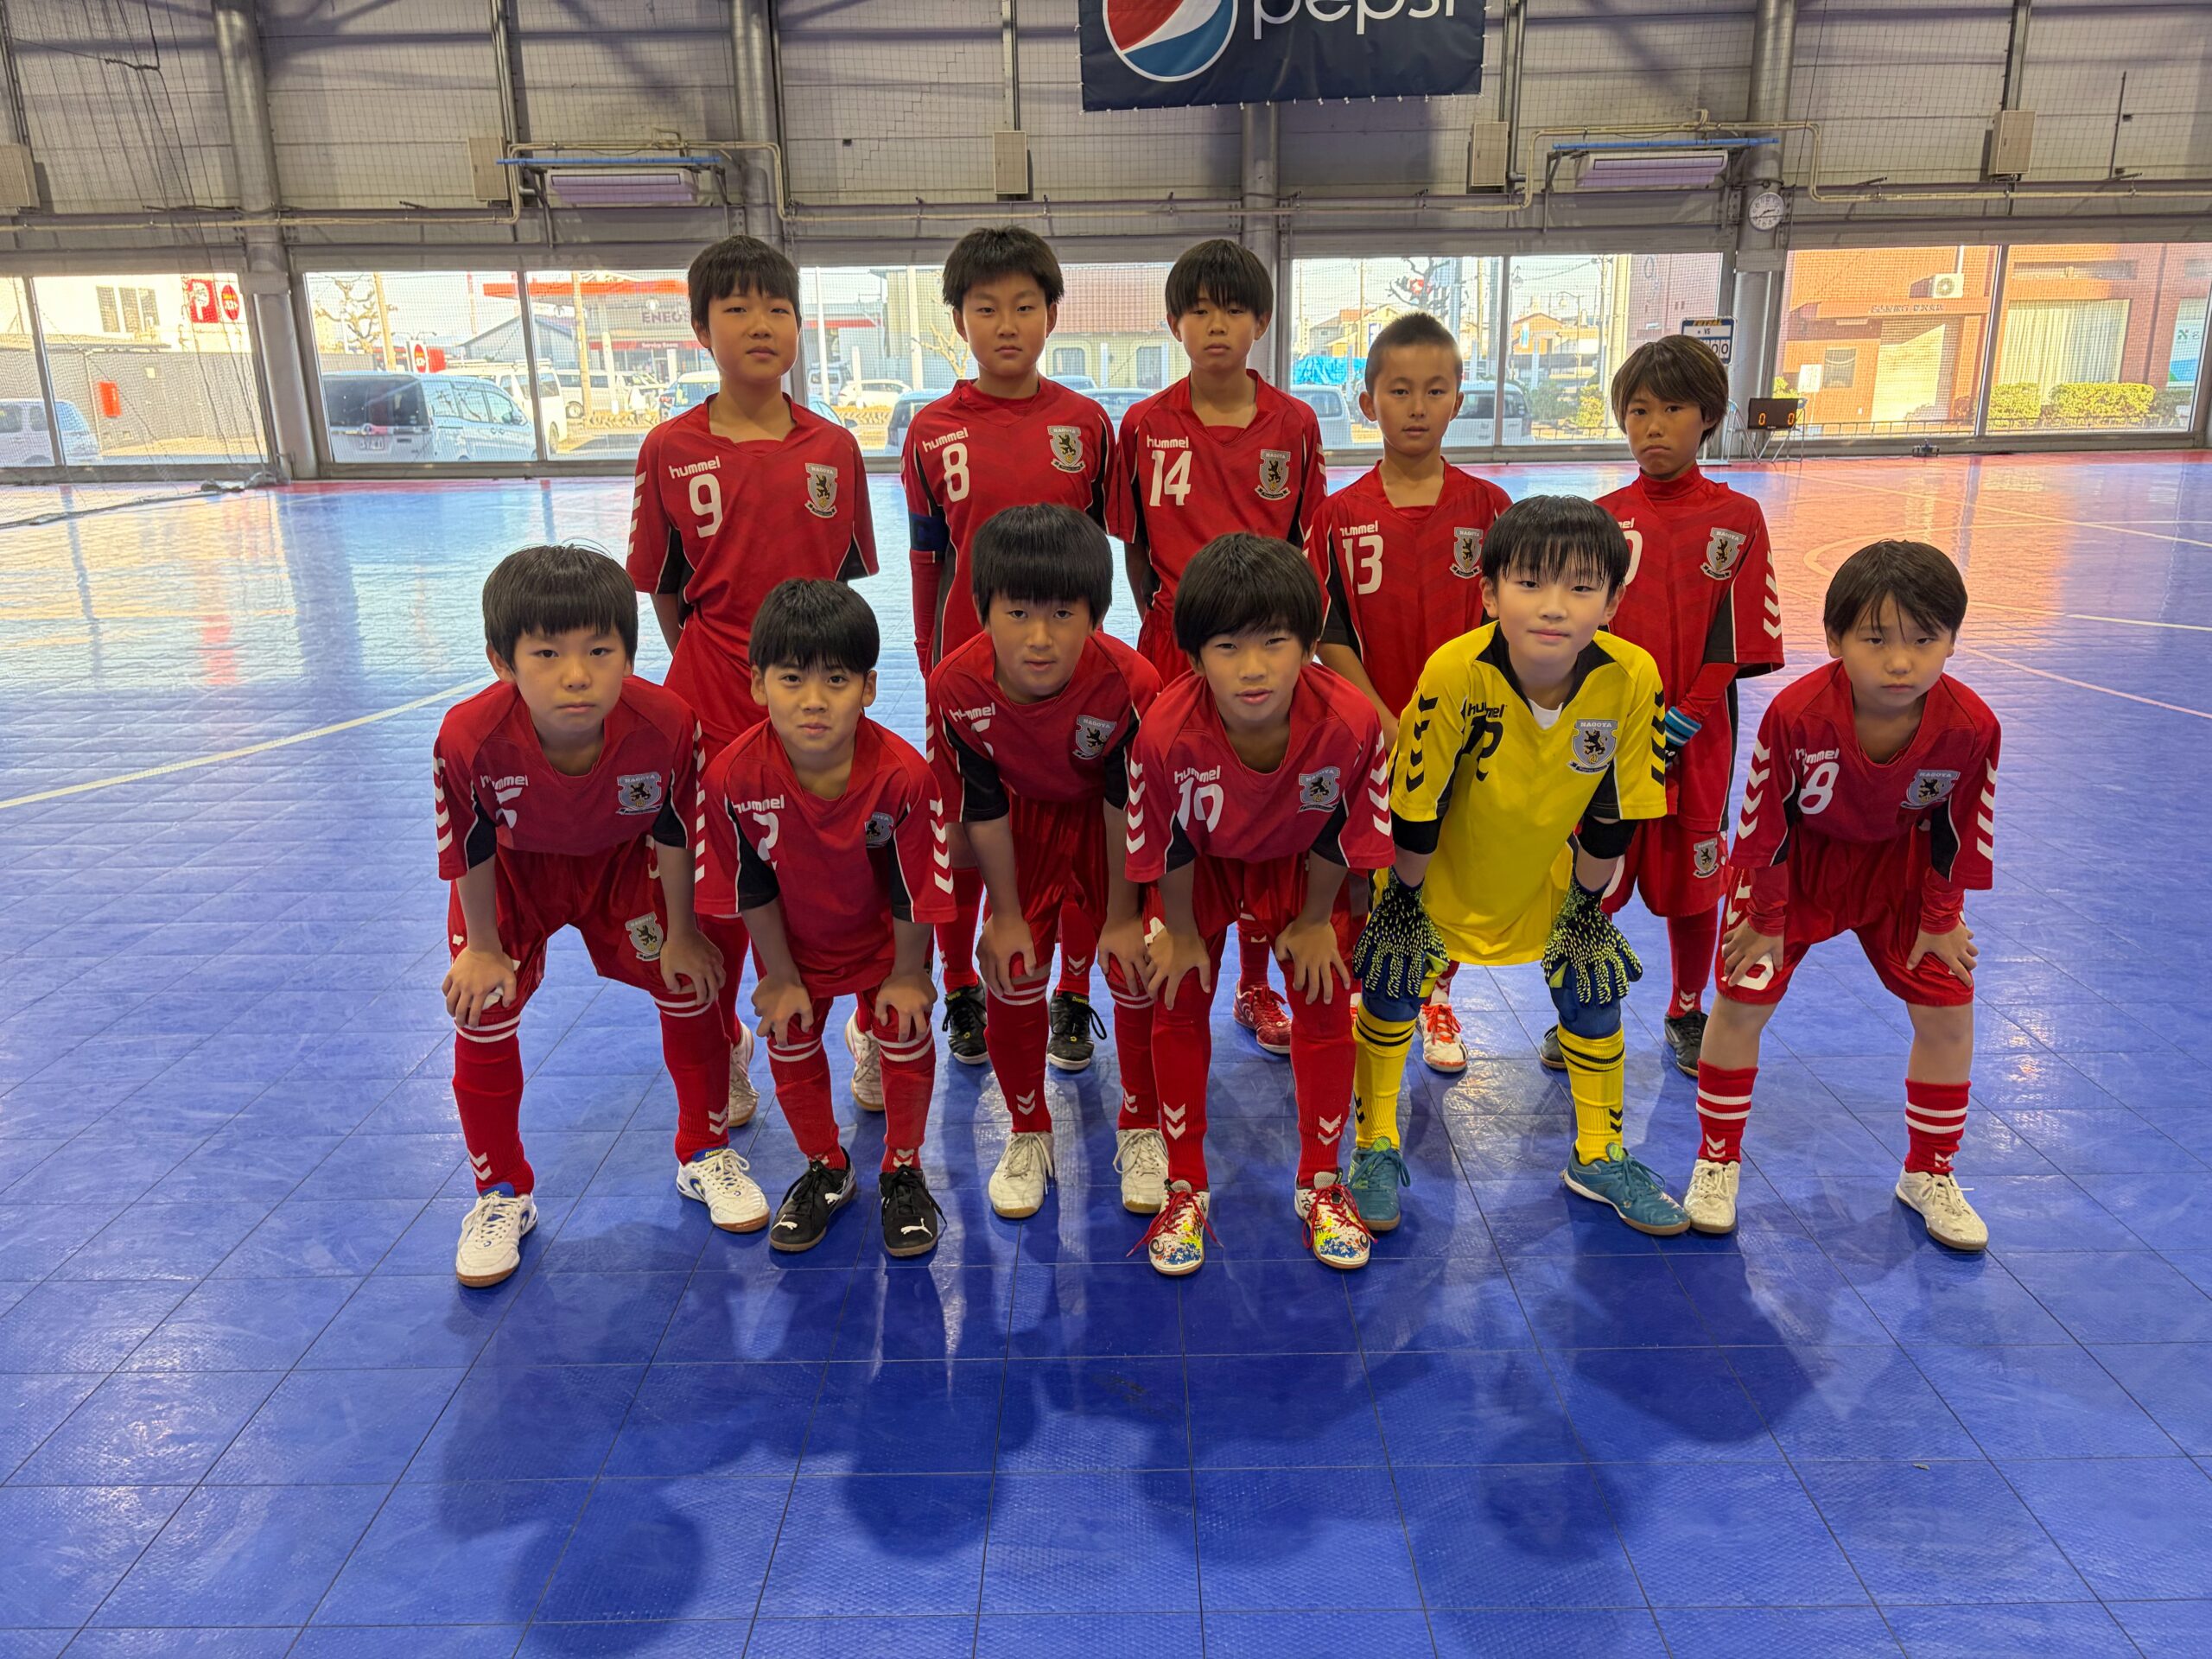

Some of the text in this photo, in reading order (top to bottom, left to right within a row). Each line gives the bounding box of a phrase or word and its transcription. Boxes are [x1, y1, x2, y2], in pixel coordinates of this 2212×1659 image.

[1758, 412, 1796, 426] 0 0
[922, 427, 969, 453] hummel
[1147, 435, 1189, 448] hummel
[669, 455, 721, 480] hummel
[942, 442, 970, 503] 8
[1149, 450, 1193, 507] 14
[689, 473, 723, 538] 9
[1342, 534, 1384, 595] 13
[1173, 765, 1222, 785] hummel
[1177, 777, 1224, 833] 10
